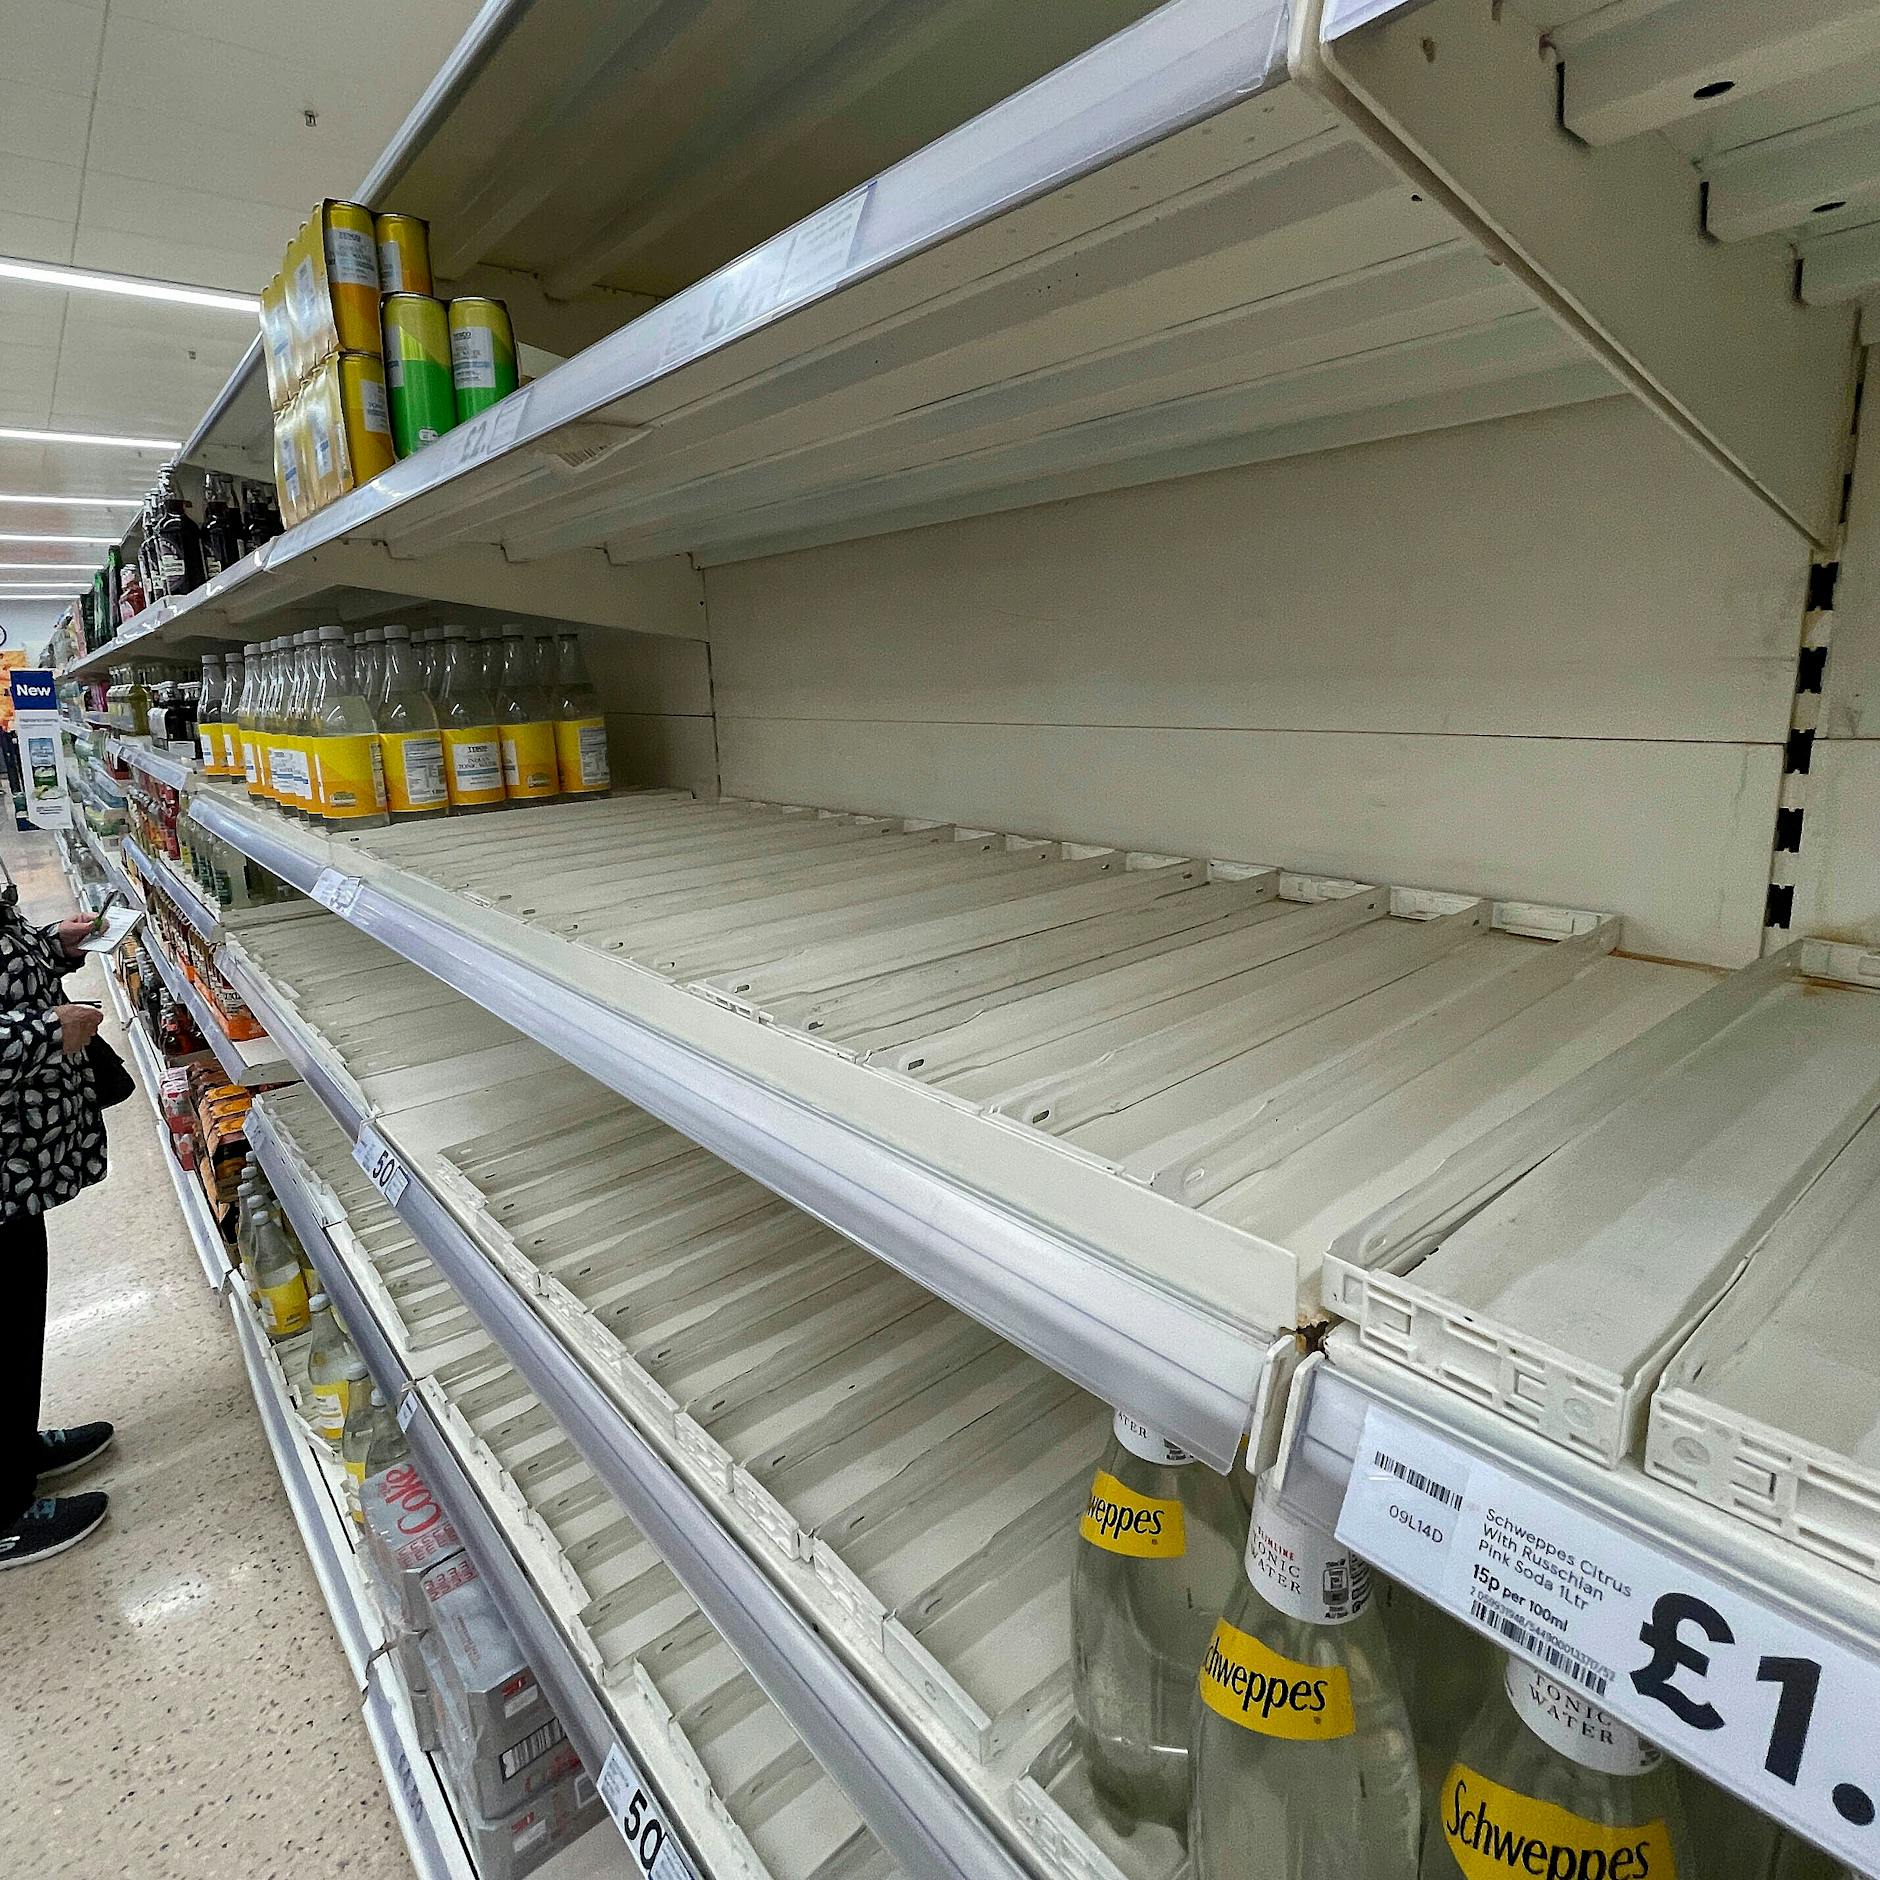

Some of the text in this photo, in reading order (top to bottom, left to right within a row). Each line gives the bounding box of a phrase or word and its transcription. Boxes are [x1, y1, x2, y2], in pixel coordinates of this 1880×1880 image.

[16, 684, 51, 696] New
[373, 1150, 394, 1187] 50
[385, 1464, 442, 1535] Coke
[1388, 1504, 1444, 1544] 09L14D
[1251, 1543, 1302, 1595] WATER
[1478, 1540, 1589, 1611] Pink Soda 1Ltr
[1482, 1524, 1603, 1601] With Russchian
[1486, 1507, 1632, 1598] Schweppes Citrus
[1472, 1564, 1569, 1632] 15p per 100ml
[1529, 1684, 1615, 1745] WATER
[1534, 1672, 1612, 1727] TONIC
[624, 1788, 663, 1870] 50
[1446, 1779, 1651, 1880] Schweppes
